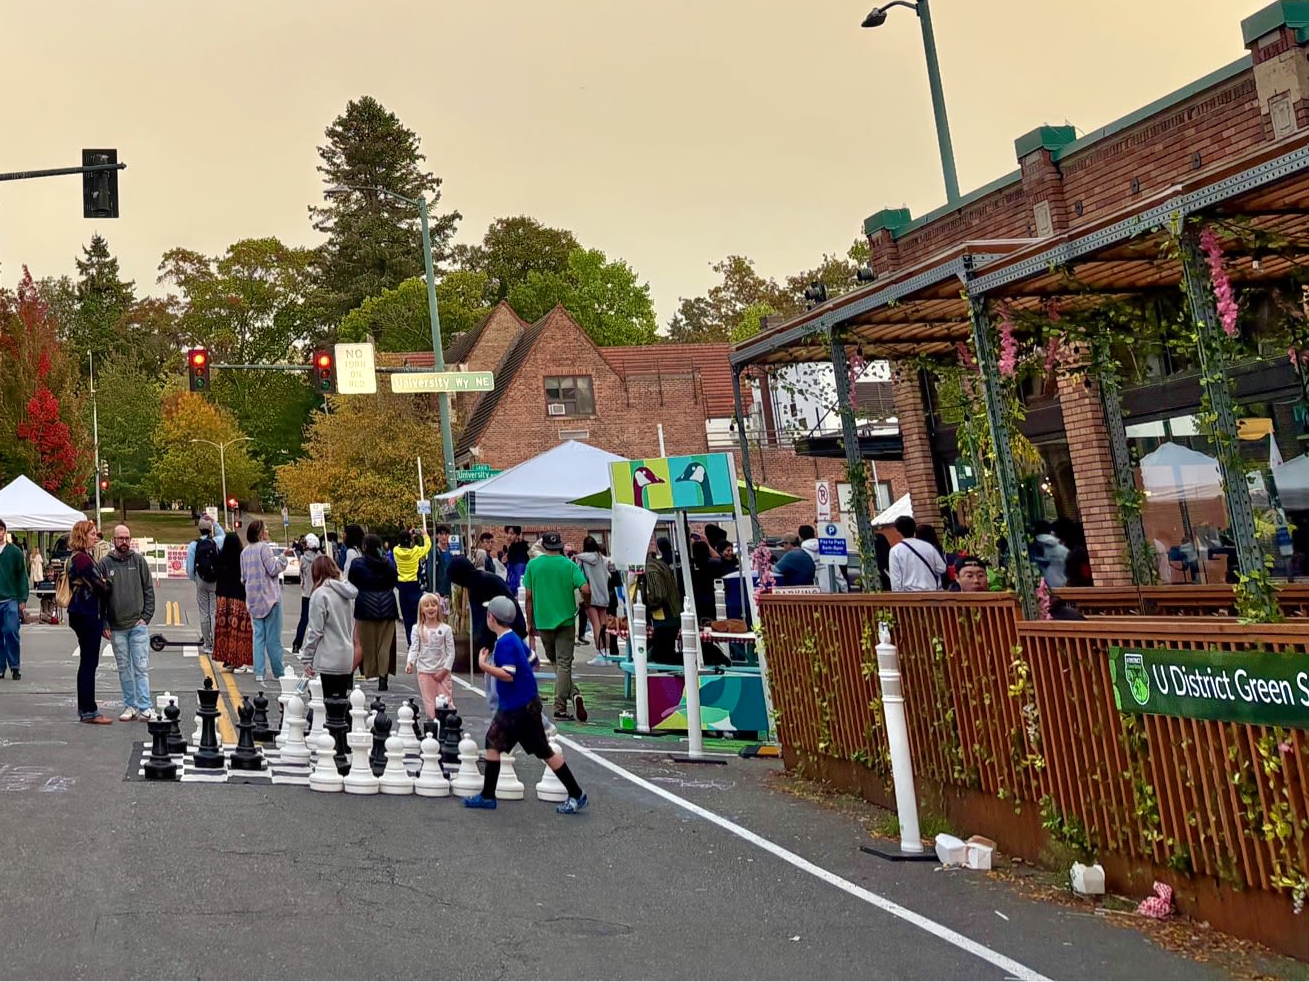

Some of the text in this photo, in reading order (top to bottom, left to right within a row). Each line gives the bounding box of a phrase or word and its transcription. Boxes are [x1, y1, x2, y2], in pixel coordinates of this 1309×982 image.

[345, 349, 363, 359] NO
[344, 360, 366, 368] TURN
[394, 376, 490, 389] University Wy NE
[1152, 664, 1169, 695] U
[1169, 665, 1235, 701] District
[1234, 668, 1296, 706] Green
